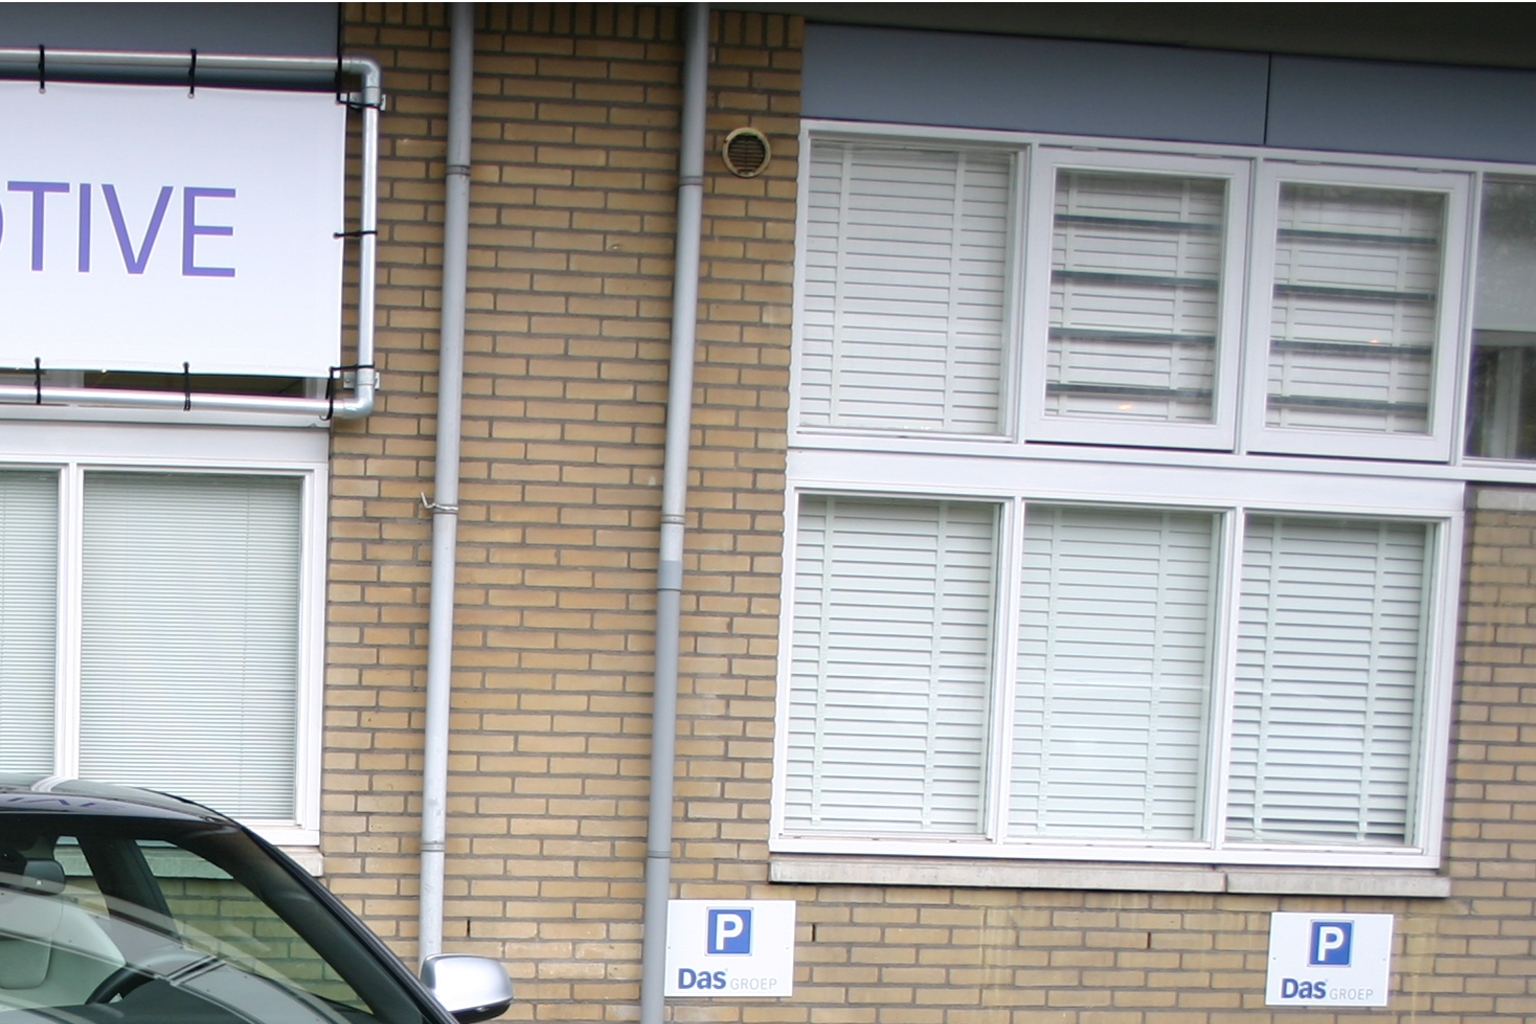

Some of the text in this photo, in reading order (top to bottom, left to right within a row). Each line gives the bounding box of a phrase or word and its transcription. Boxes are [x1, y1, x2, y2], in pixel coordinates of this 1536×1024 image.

[715, 913, 744, 951] P
[1317, 926, 1344, 962] P
[677, 967, 778, 991] Das GROEP
[1280, 977, 1374, 1001] Das GROEP
